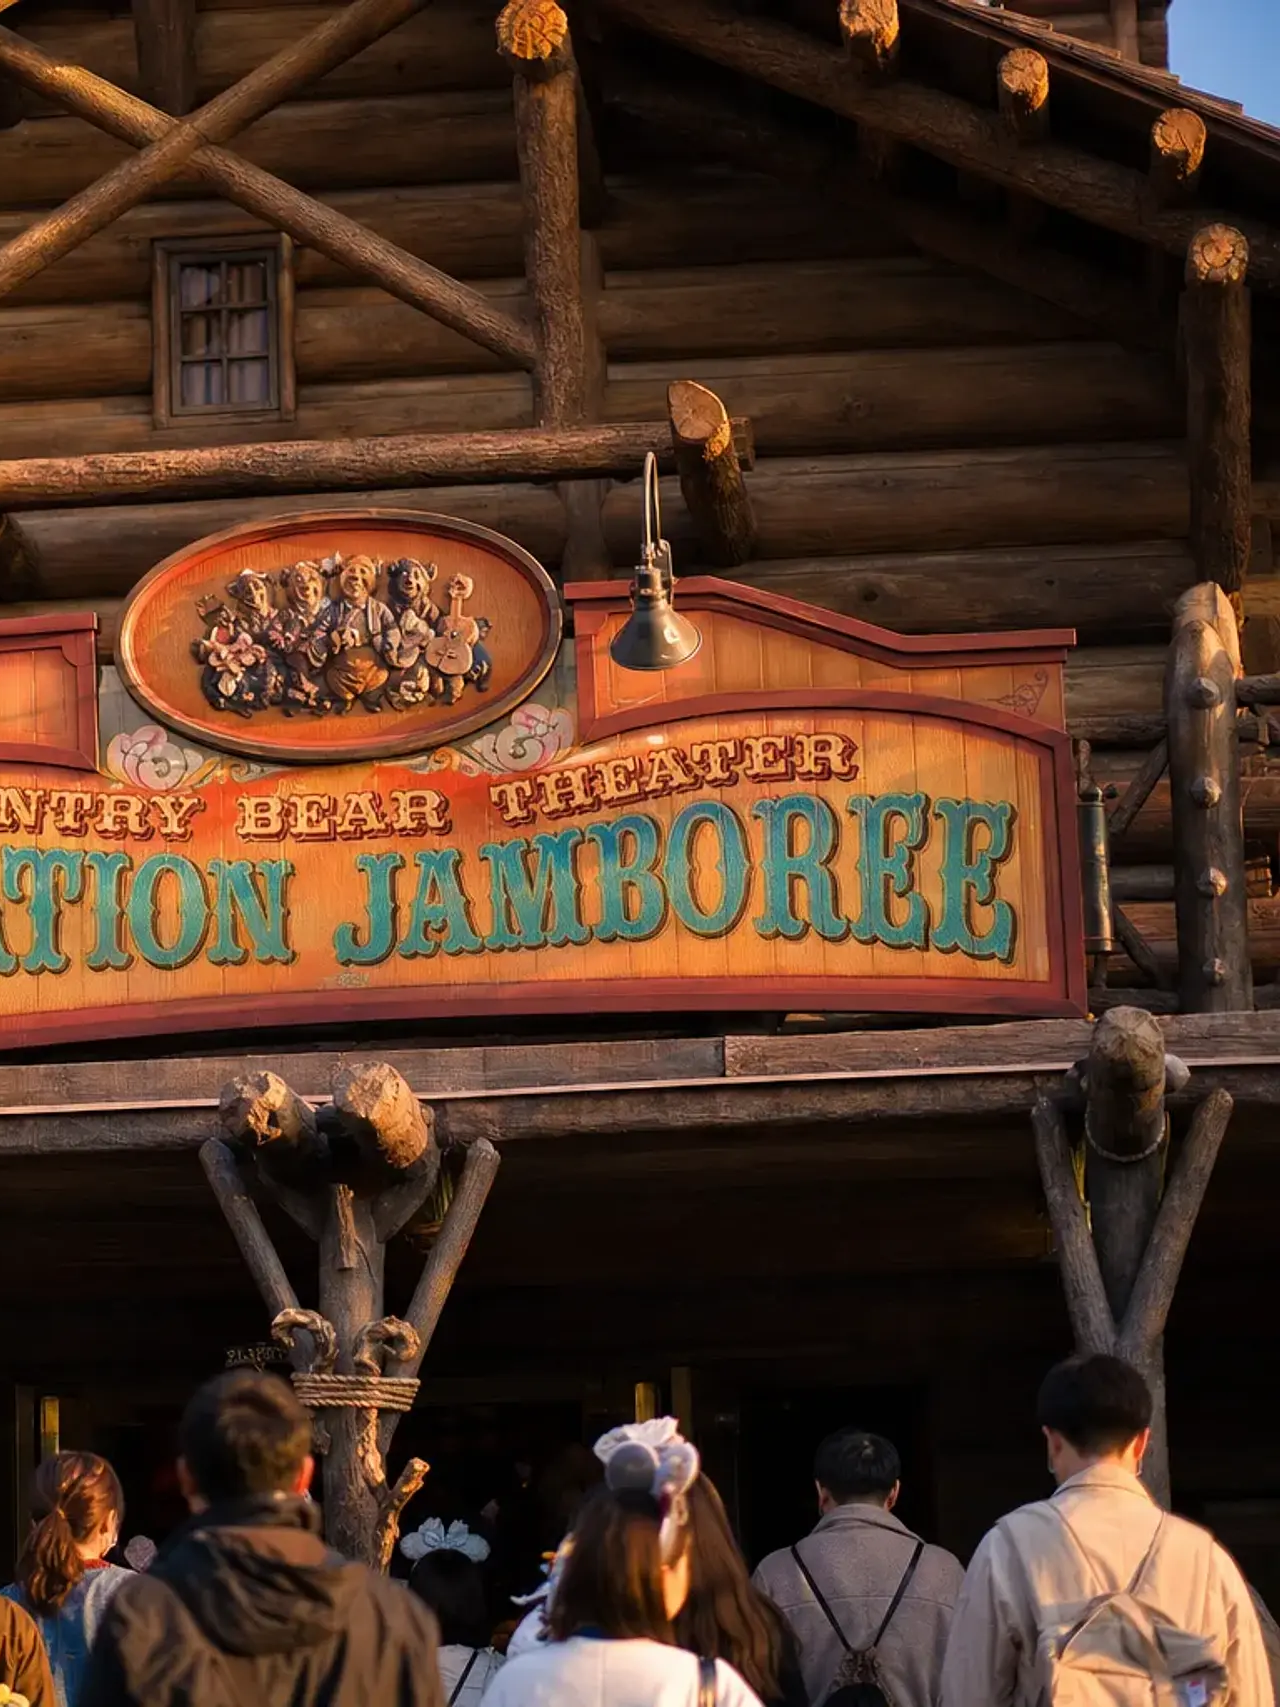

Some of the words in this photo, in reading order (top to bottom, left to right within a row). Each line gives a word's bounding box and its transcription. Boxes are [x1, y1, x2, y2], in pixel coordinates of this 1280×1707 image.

[236, 790, 453, 842] BEAR
[489, 732, 859, 826] THEATER
[333, 790, 1017, 966] JAMBOREE
